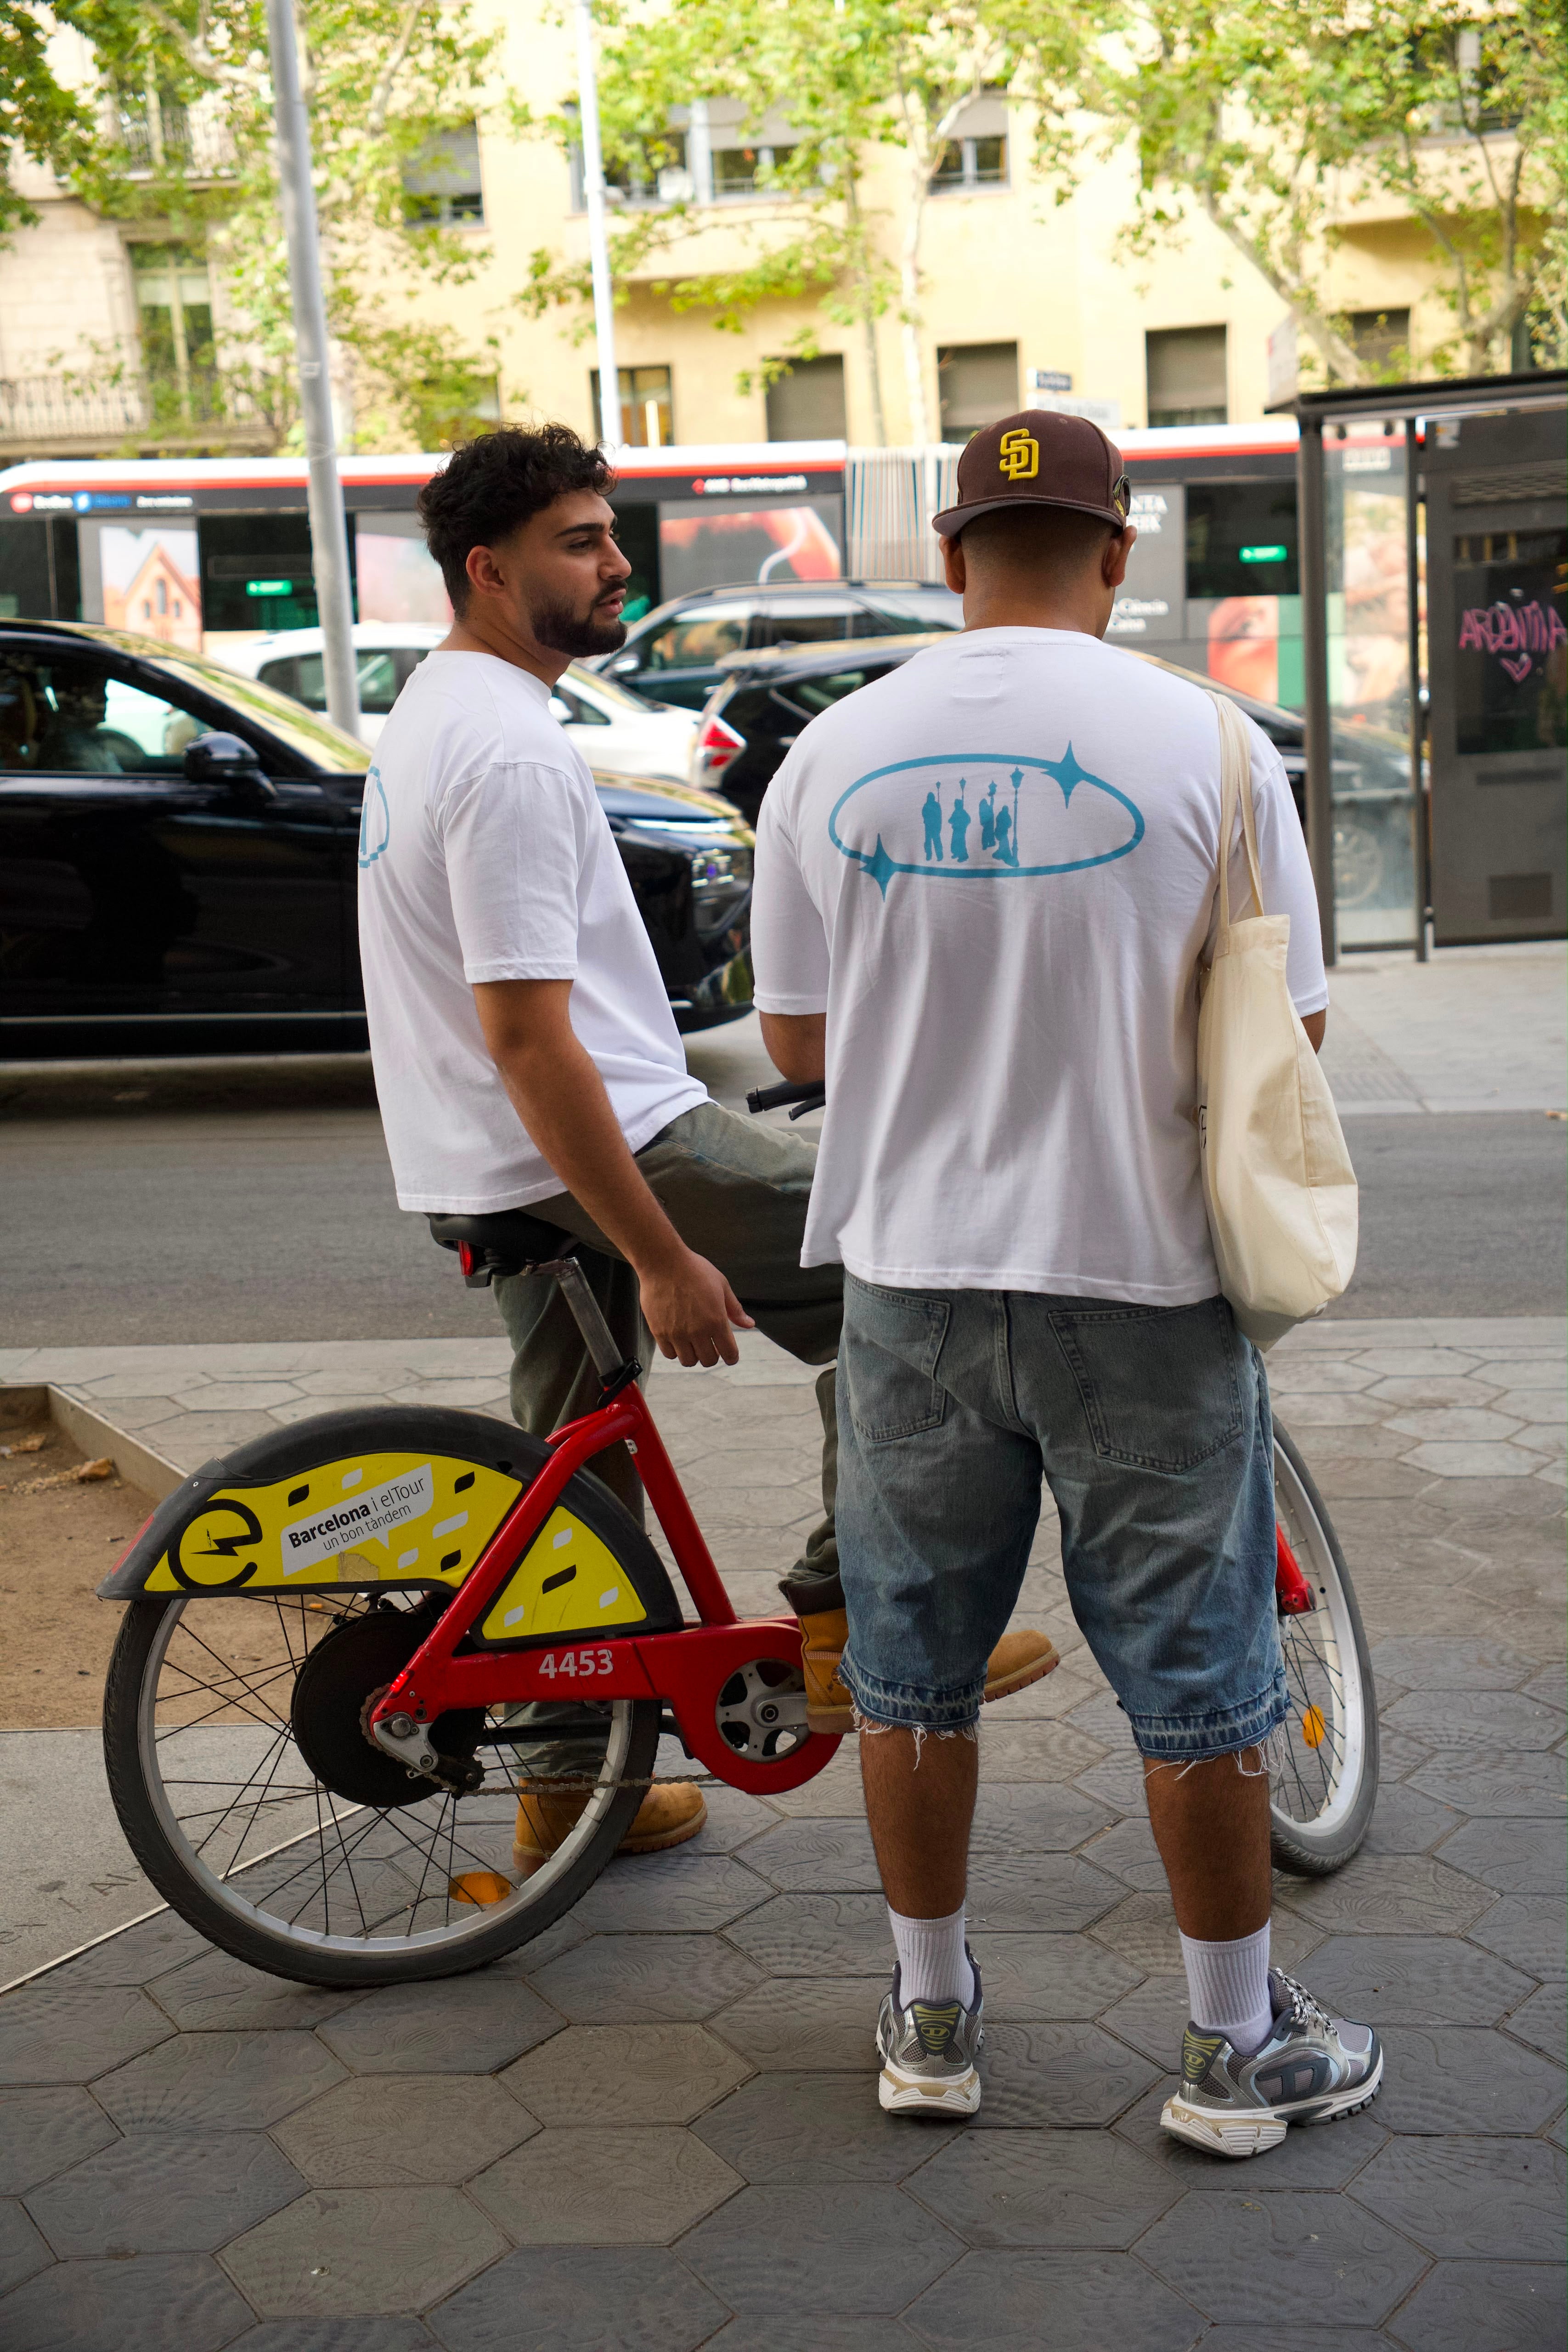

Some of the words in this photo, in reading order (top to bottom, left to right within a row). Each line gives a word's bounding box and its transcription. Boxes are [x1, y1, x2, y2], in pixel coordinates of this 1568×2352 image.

[999, 428, 1039, 481] SD
[288, 1504, 371, 1549] Barcelona
[371, 1497, 378, 1512] i
[323, 1537, 339, 1550] un
[339, 1525, 364, 1543] bon
[365, 1504, 412, 1532] tàndem
[538, 1649, 614, 1679] 4453
